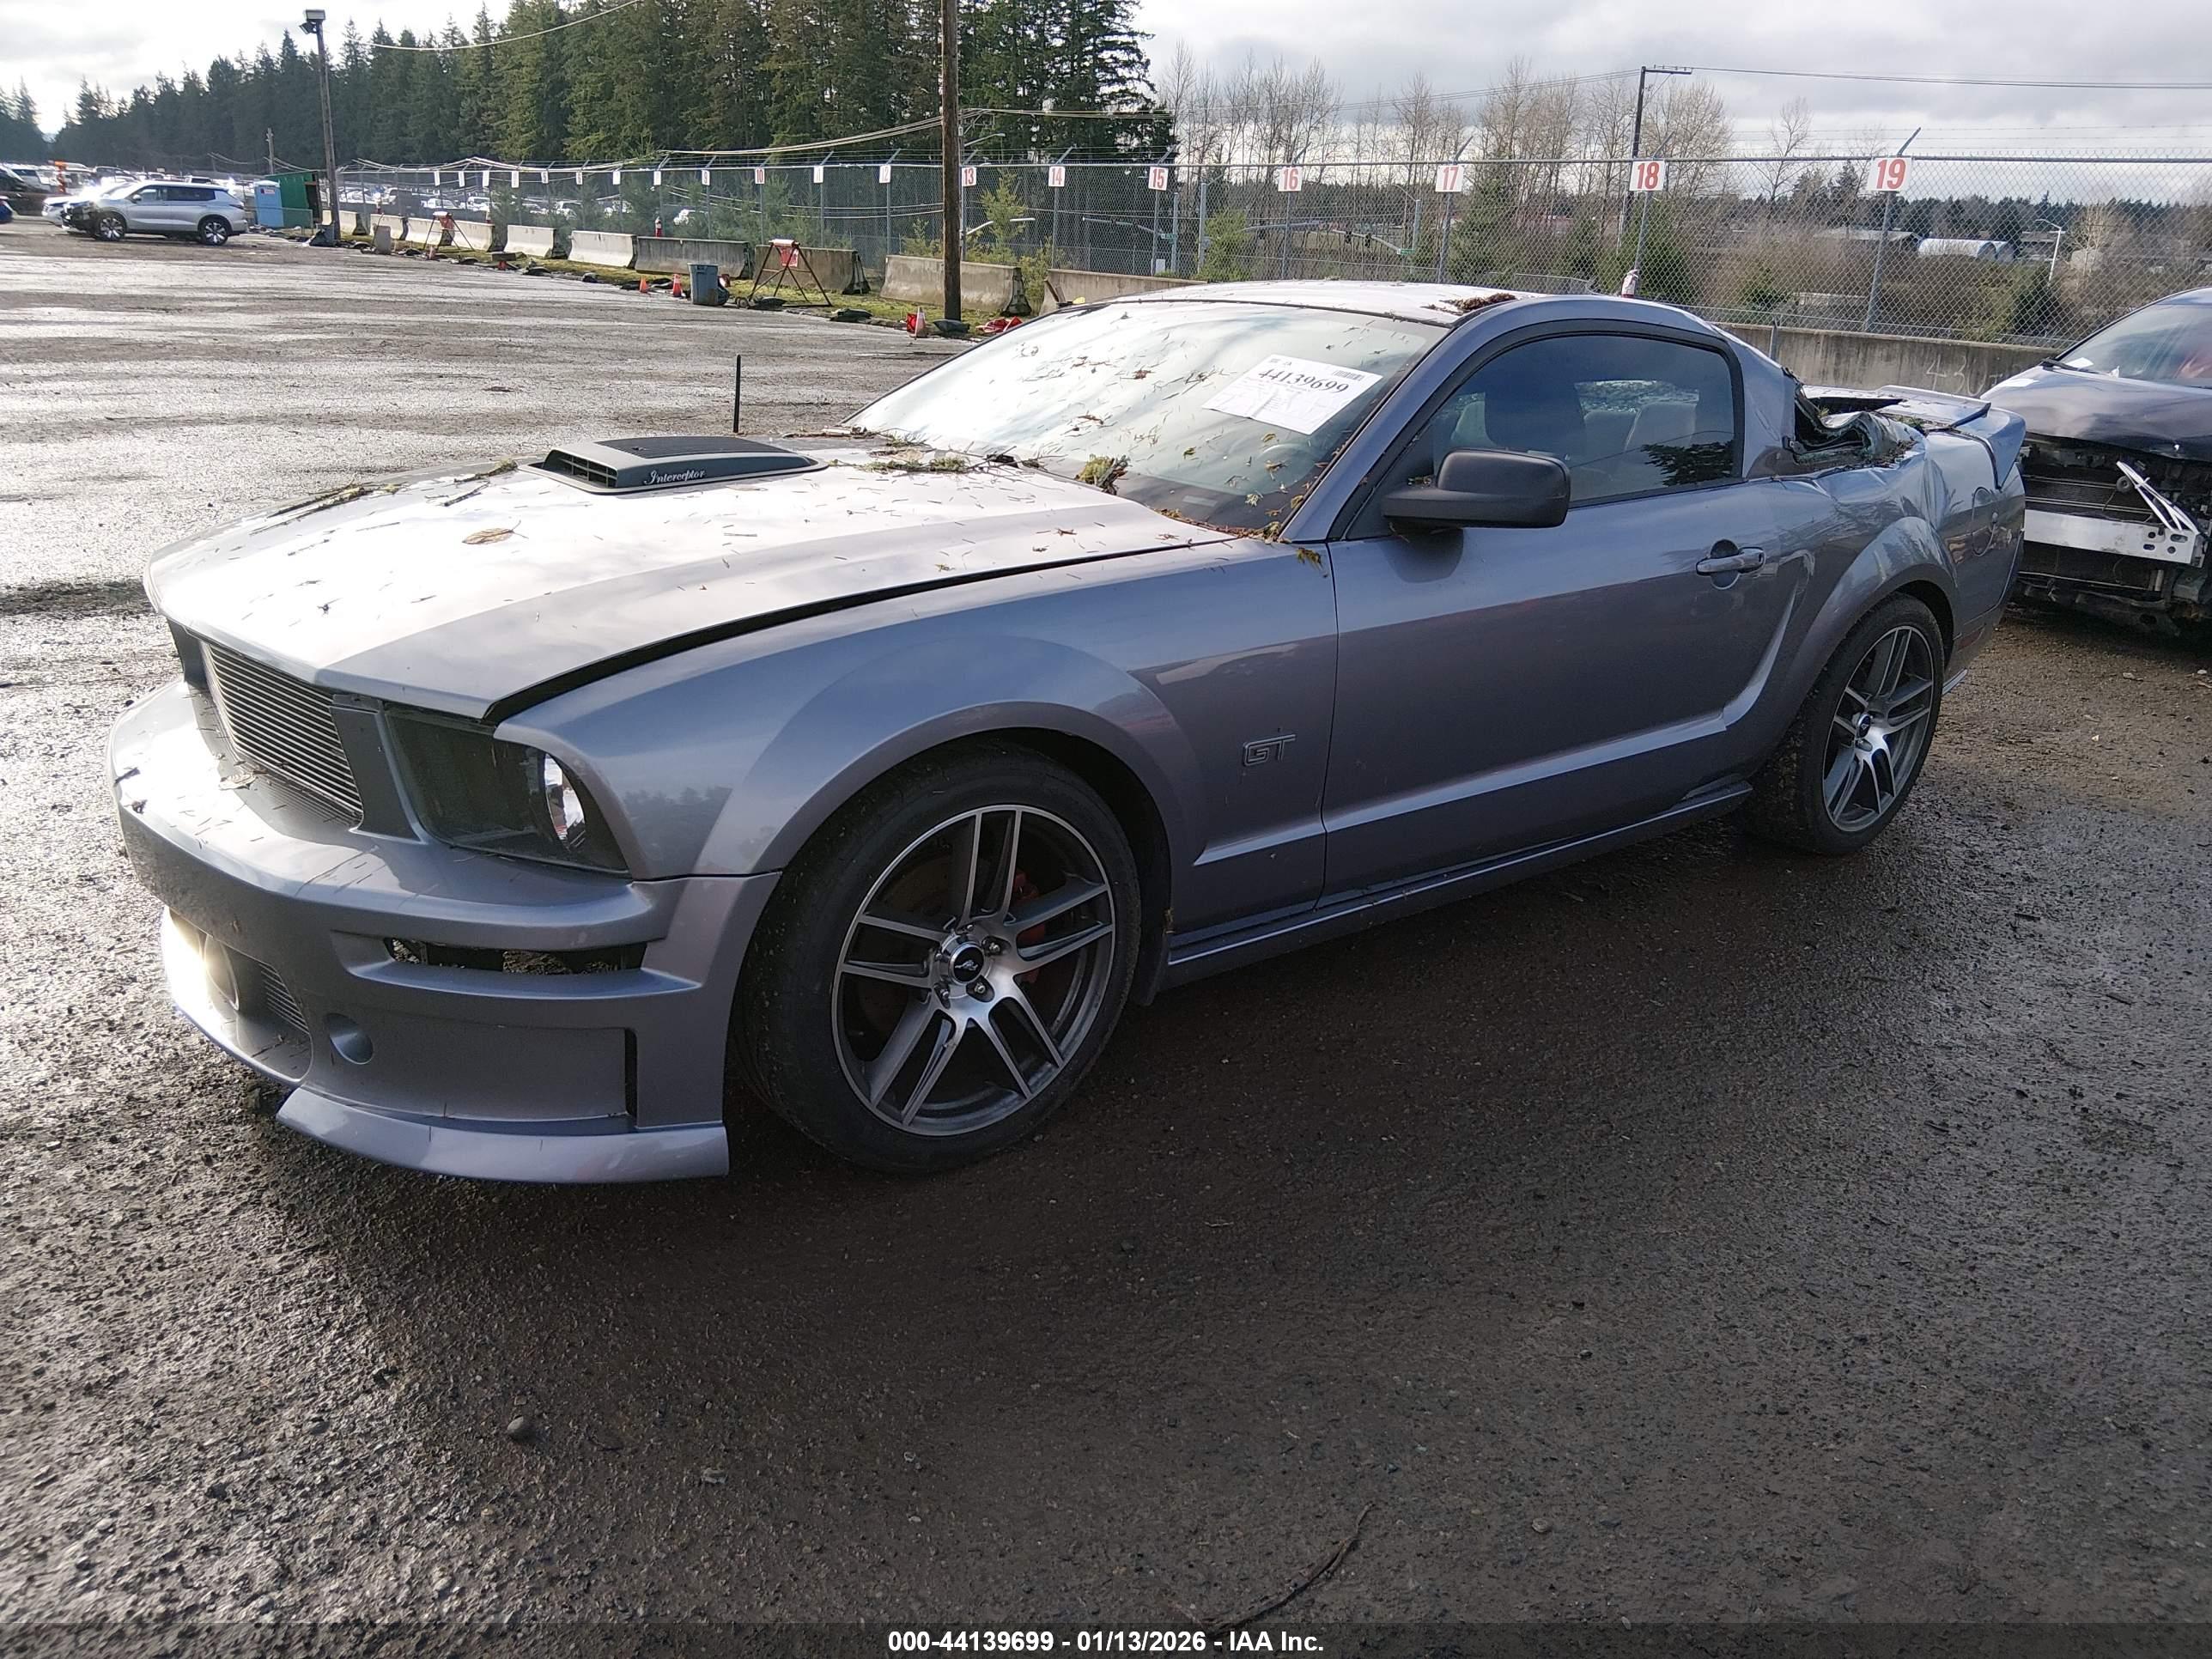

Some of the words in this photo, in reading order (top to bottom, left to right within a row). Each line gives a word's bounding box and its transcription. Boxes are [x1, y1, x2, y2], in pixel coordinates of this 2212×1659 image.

[756, 169, 763, 183] 10
[963, 167, 975, 185] 13
[1052, 167, 1062, 185] 14
[1152, 168, 1165, 189] 15
[1283, 167, 1298, 190] 16
[1443, 167, 1459, 190] 17
[1638, 161, 1660, 189] 18
[1876, 159, 1906, 189] 19
[1258, 368, 1349, 393] 44139699
[643, 470, 705, 485] Interceptor
[1243, 733, 1297, 766] GT
